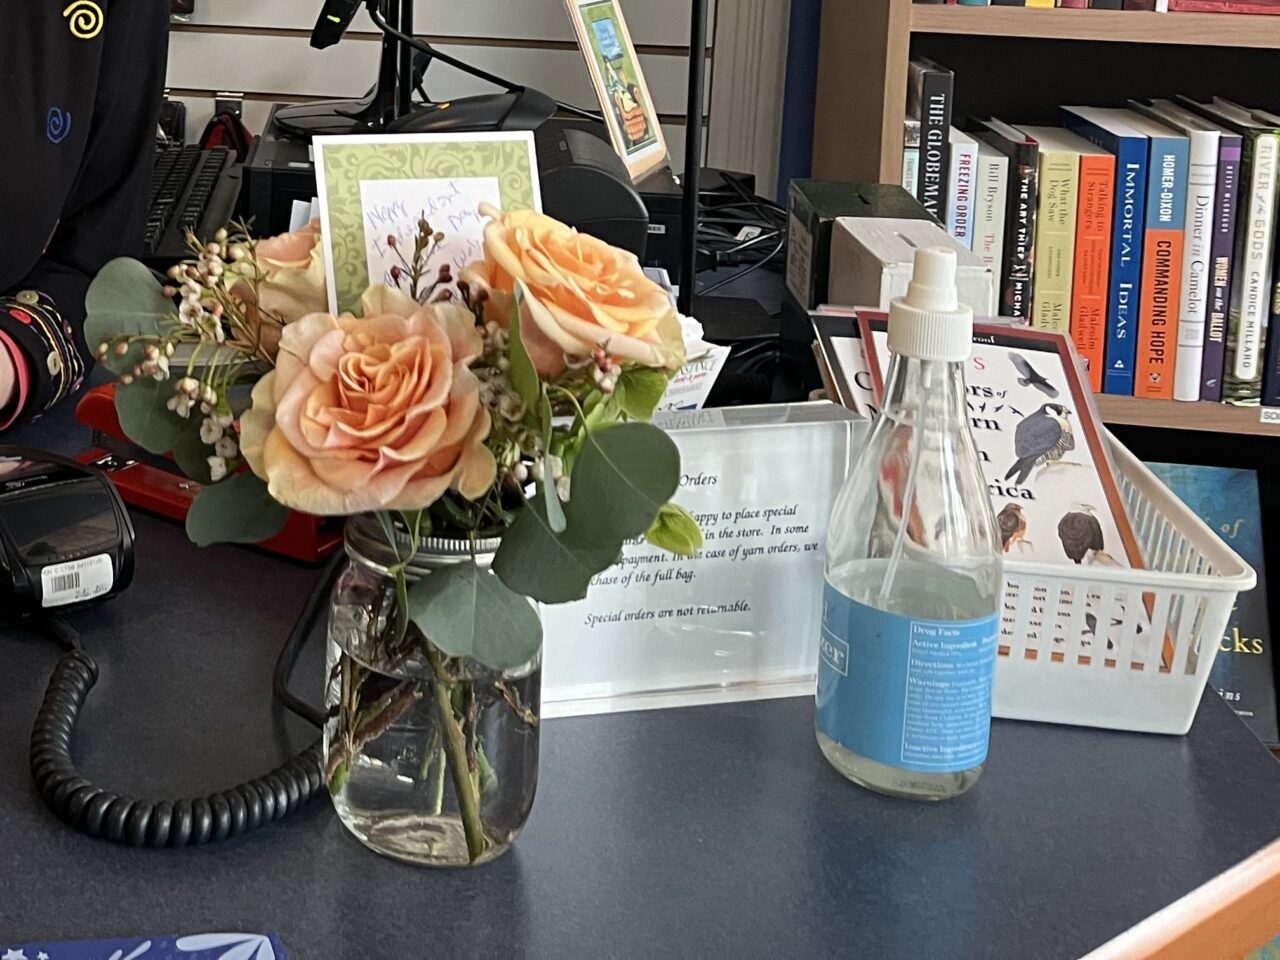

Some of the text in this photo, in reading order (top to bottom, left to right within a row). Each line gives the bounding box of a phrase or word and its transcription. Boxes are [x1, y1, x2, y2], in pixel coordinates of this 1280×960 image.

[928, 94, 945, 125] THE
[954, 153, 971, 238] FREEZING ORDER
[983, 163, 1000, 252] Bill Bryson The
[1047, 180, 1060, 222] Dog Saw
[1058, 178, 1071, 225] What the
[1085, 181, 1097, 230] Strangers
[1096, 180, 1108, 218] Talking
[1159, 154, 1176, 222] HOMER-DIXON
[1251, 145, 1273, 261] RIVER GODS
[1017, 178, 1028, 259] THE ART THIEF
[1221, 193, 1231, 233] McGREGOR
[1117, 162, 1140, 339] IMMORTAL IDEAS
[1186, 194, 1210, 314] Dinner in Camelot
[1149, 240, 1171, 365] COMMANDING HOPE
[1209, 257, 1229, 343] WOMEN BALLOT
[1242, 271, 1260, 370] CANDICE MILLARD
[1077, 306, 1087, 350] Gladwell
[1089, 307, 1100, 350] Malcolm
[996, 389, 1008, 399] of
[679, 473, 718, 488] Orders
[705, 524, 809, 540] in the store. In some
[722, 504, 798, 524] to place special
[705, 548, 726, 559] case
[728, 544, 740, 560] of
[742, 545, 765, 561] yarn
[768, 541, 801, 554] orders,
[804, 542, 820, 551] we
[620, 568, 697, 587] of the full bag.
[584, 601, 752, 628] Special orders are not returnable.
[913, 624, 961, 637] Drug Facts
[912, 638, 978, 649] Active Ingredient
